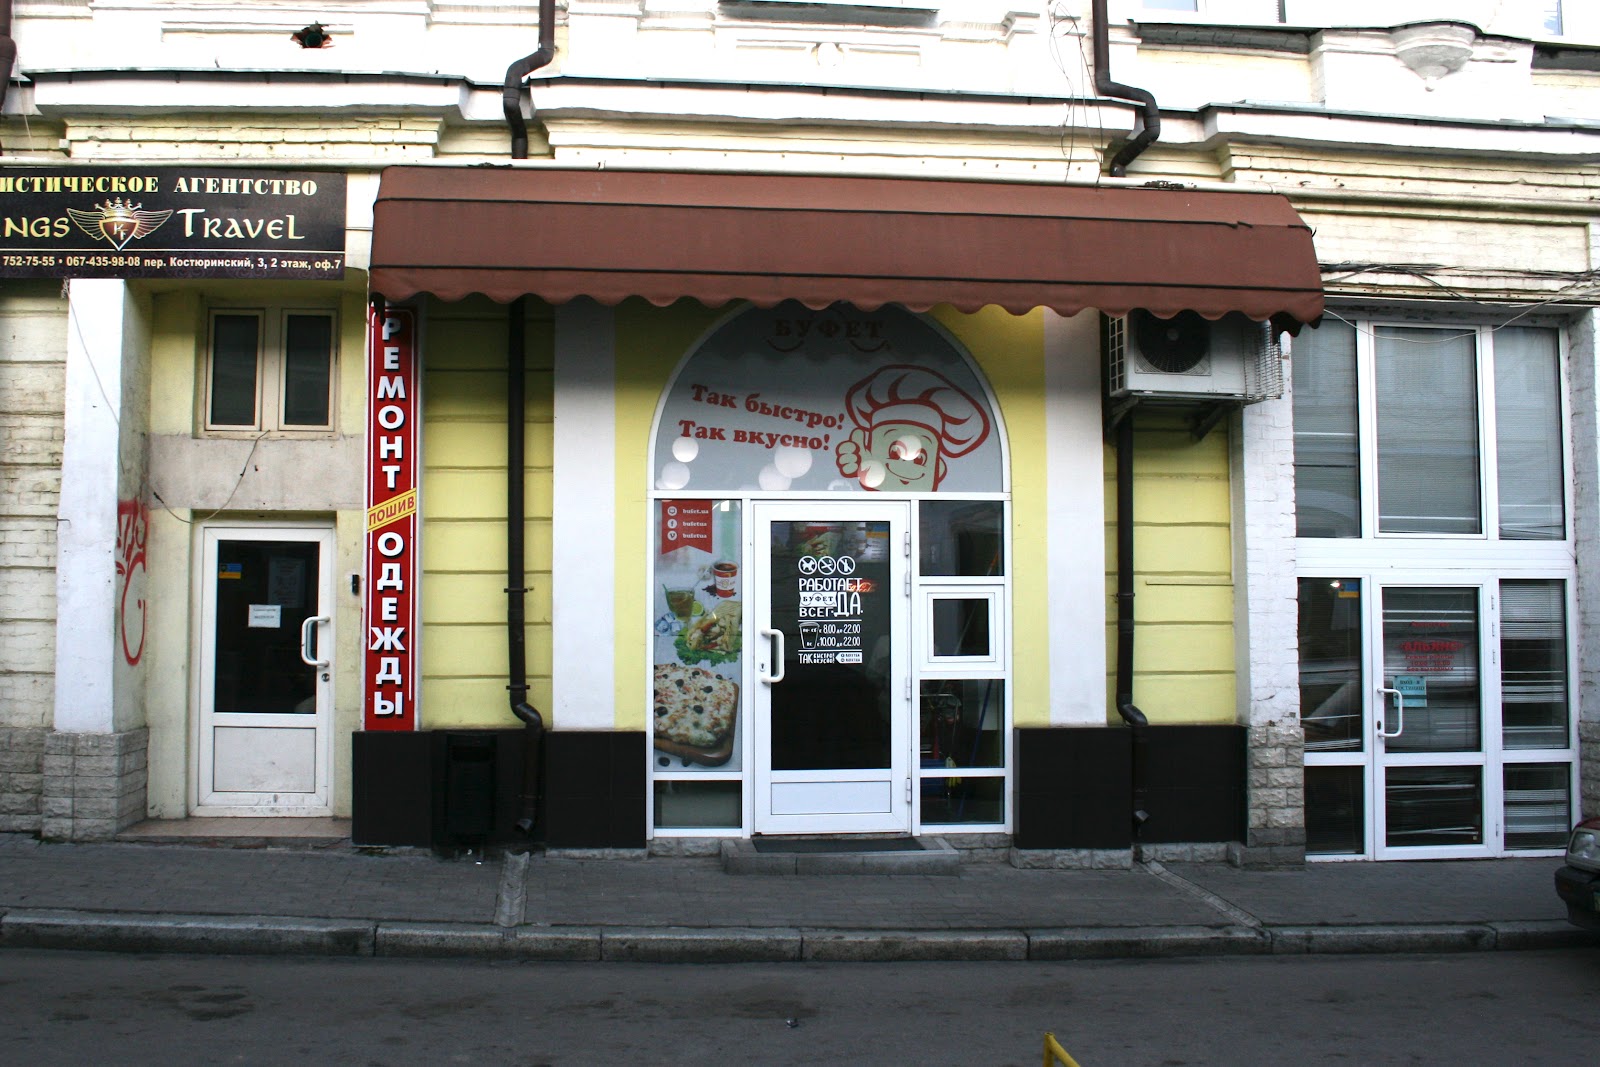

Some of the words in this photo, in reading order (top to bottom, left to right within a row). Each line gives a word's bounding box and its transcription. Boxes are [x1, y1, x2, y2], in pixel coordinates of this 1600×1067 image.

[173, 176, 318, 196] АГЕНТСТВО
[0, 217, 70, 239] NGS
[2, 255, 55, 267] 752-75-55
[66, 256, 141, 267] 067-435-98-08
[144, 258, 167, 269] пер.
[170, 257, 255, 269] Костюринский,
[258, 258, 268, 269] 3,
[270, 258, 278, 268] 2
[281, 260, 312, 270] этаж,
[314, 259, 342, 270] оф.7
[775, 318, 885, 338] БУФЕТ
[375, 317, 407, 490] РЕМОНТ
[692, 383, 738, 410] Так
[744, 391, 846, 431] быстро!
[679, 419, 726, 441] Так
[733, 428, 831, 451] вкусно!
[367, 494, 415, 528] ПОШИВ
[799, 577, 863, 591] РАБОТАЕТ
[802, 595, 834, 603] БУФЕТ
[370, 531, 407, 716] ОДЕЖДЫ
[843, 624, 861, 635] 22.00
[843, 636, 861, 647] 22.00
[798, 653, 814, 664] ТАК
